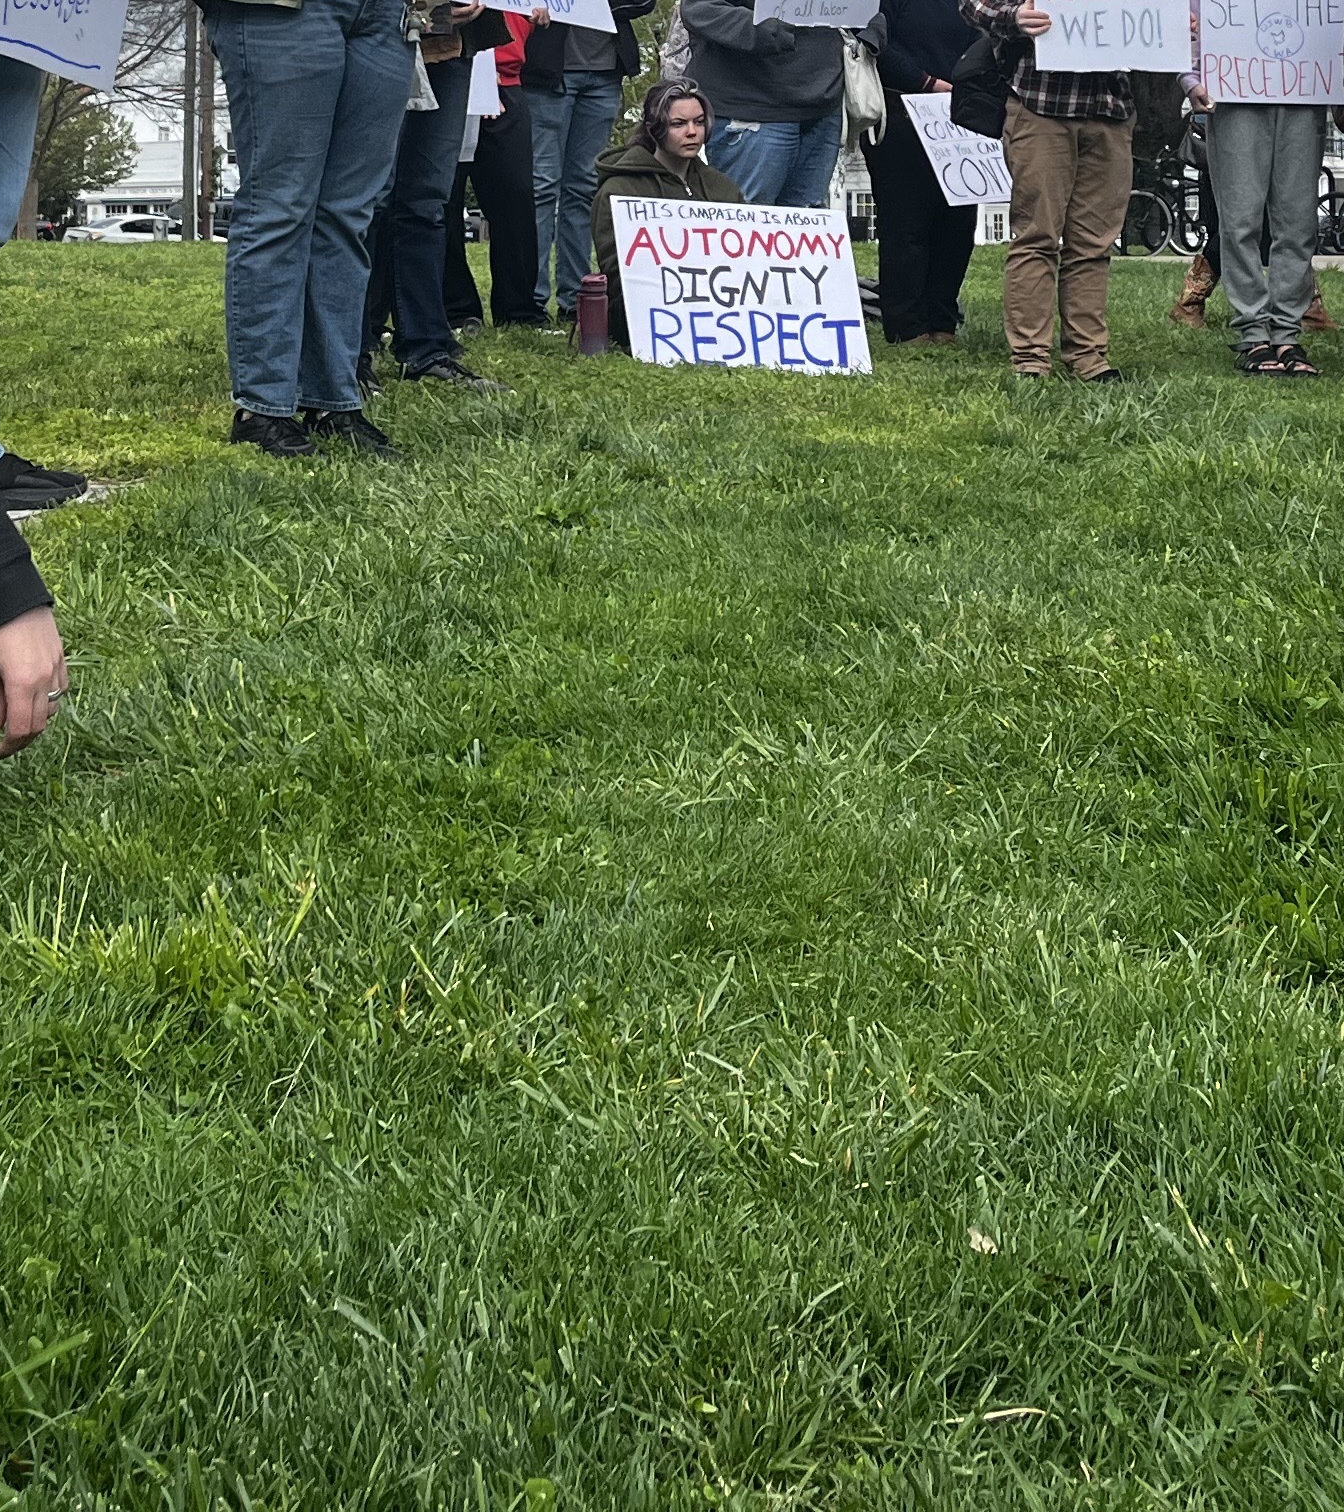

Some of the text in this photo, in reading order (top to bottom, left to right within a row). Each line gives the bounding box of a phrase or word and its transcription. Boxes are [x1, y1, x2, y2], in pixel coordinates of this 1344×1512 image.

[819, 0, 849, 17] labor
[1059, 7, 1164, 49] WE DO!
[1203, 51, 1344, 98] PRECEDEN
[976, 141, 1001, 155] CAN
[942, 156, 1012, 198] CONT
[617, 199, 674, 222] THIS
[678, 203, 756, 224] CAMPAIGN
[784, 212, 832, 226] ABOUT
[624, 226, 845, 267] AUTONOMY
[661, 264, 829, 309] DIGNTY
[649, 307, 861, 368] RESPECT
